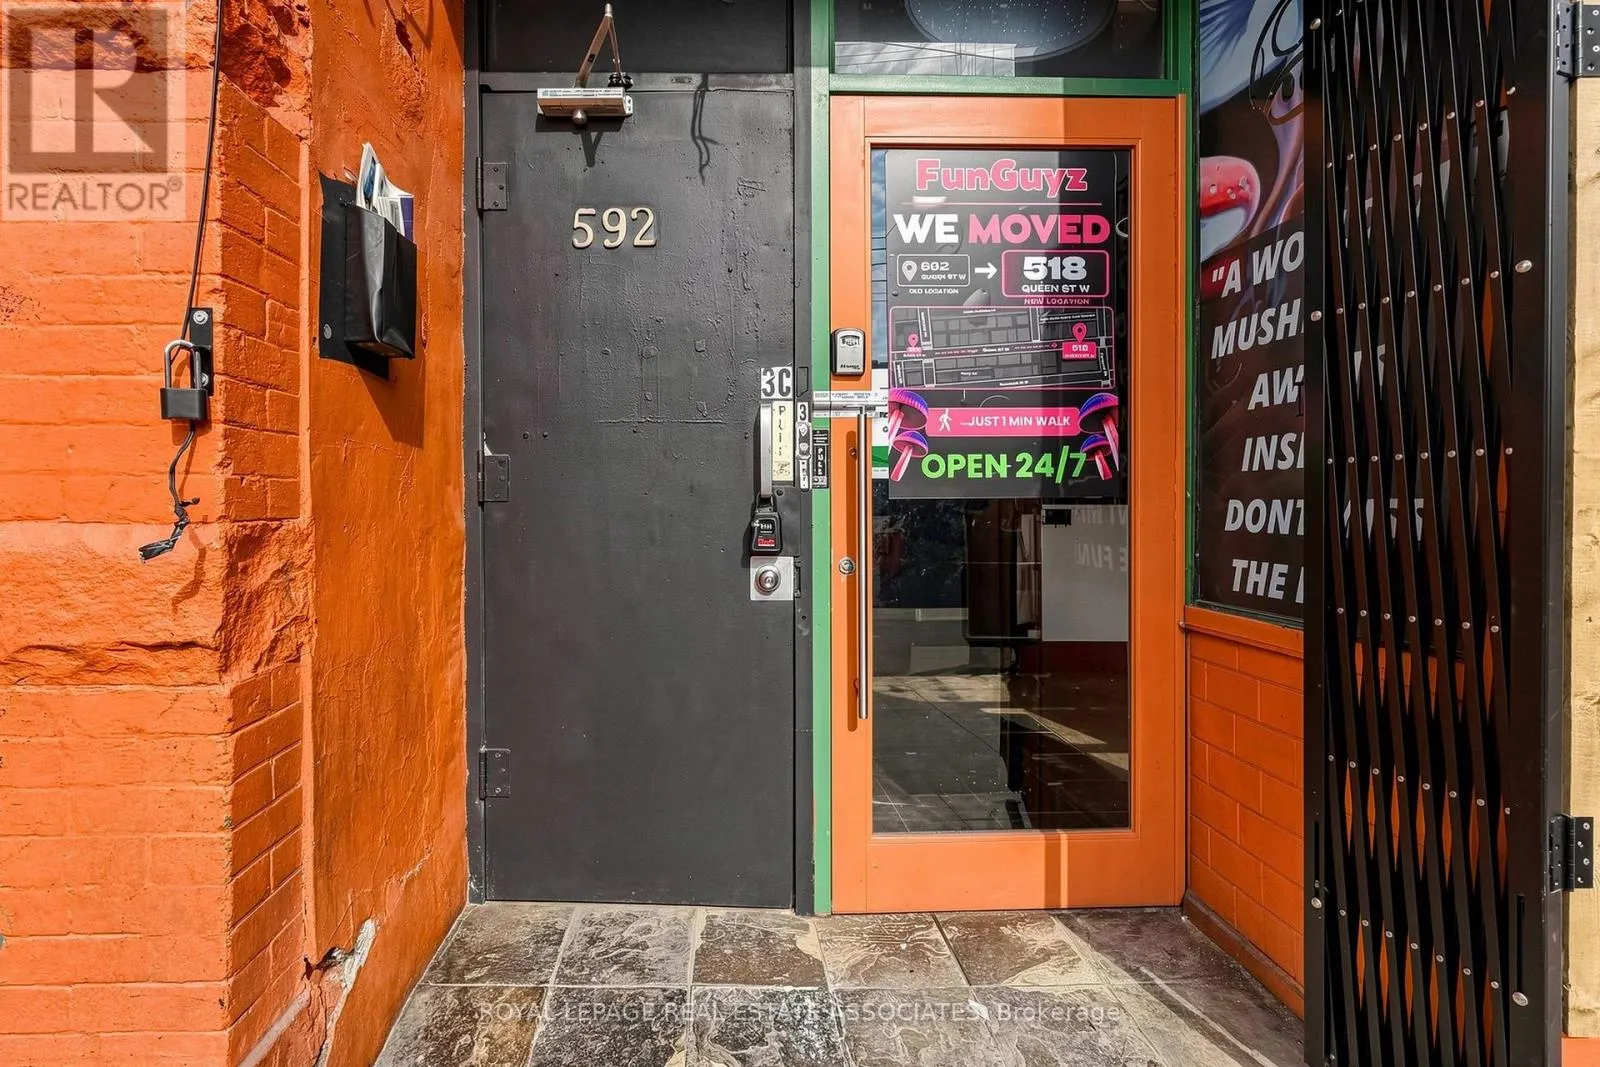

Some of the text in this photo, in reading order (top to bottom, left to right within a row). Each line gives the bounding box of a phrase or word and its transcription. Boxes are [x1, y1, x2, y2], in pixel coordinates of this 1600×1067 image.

[916, 158, 1088, 198] FunGuyz
[572, 207, 657, 248] 592
[893, 213, 1111, 244] WE MOVED
[1023, 256, 1087, 281] 518
[1021, 285, 1090, 294] QUEEN ST W
[1211, 298, 1305, 360] MUSH
[761, 367, 792, 397] 3C
[799, 403, 807, 421] 3
[967, 416, 999, 427] JUST
[1009, 416, 1033, 427] MIN
[1035, 415, 1071, 426] WALK
[921, 445, 1087, 485] OPEN 24/7
[1232, 558, 1289, 601] THE
